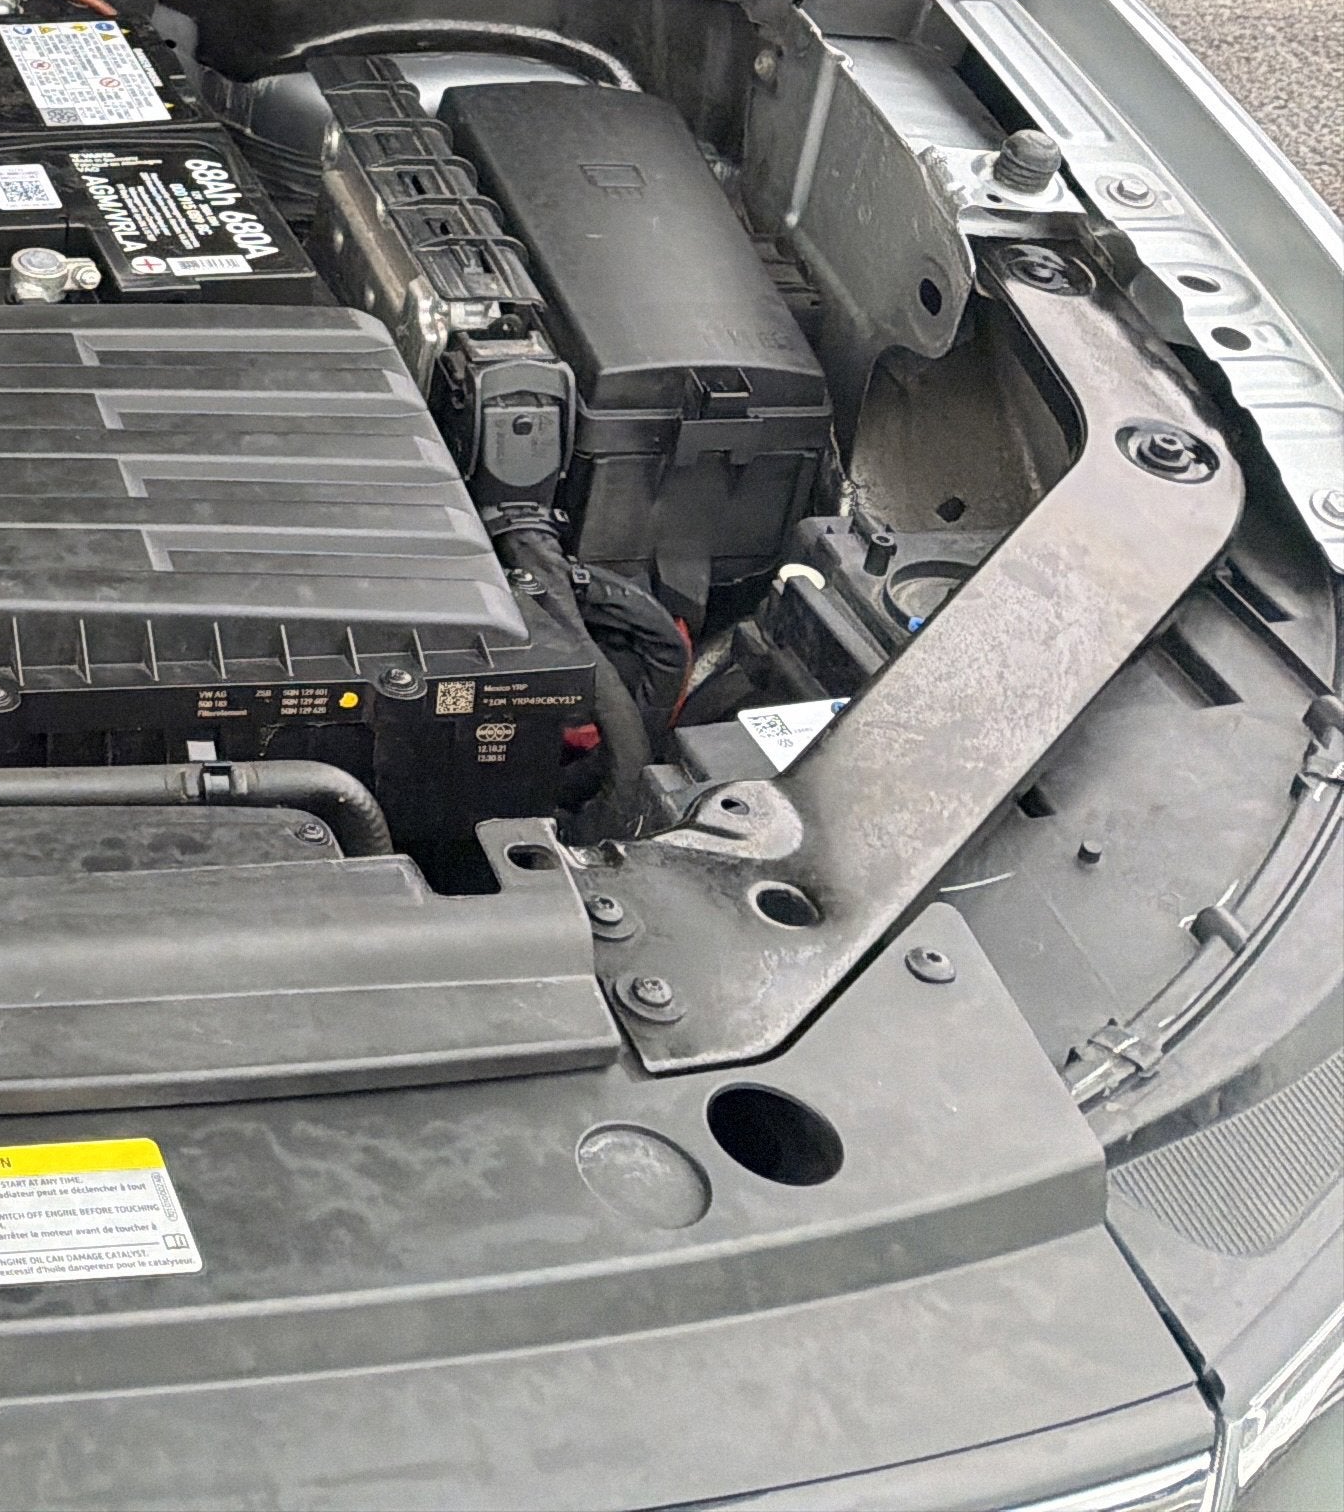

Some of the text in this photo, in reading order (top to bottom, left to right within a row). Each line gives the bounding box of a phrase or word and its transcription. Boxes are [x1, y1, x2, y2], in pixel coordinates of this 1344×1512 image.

[185, 159, 242, 206] 68Ah
[218, 210, 280, 260] 680A
[0, 1179, 27, 1189] START
[27, 1178, 39, 1187] AT
[39, 1177, 58, 1186] ANY
[35, 1187, 58, 1199] peut
[57, 1188, 69, 1196] se
[118, 1183, 126, 1192] à
[125, 1182, 147, 1191] tout
[25, 1210, 43, 1220] OFF
[43, 1208, 79, 1219] ENGINE
[78, 1205, 115, 1216] BEFORE
[113, 1202, 161, 1214] TOUCHING
[28, 1229, 40, 1238] le
[39, 1228, 73, 1238] moteur
[75, 1226, 101, 1236] avant
[101, 1224, 114, 1234] de
[114, 1222, 150, 1233] toucher
[150, 1221, 158, 1231] à
[28, 1255, 45, 1265] OIL
[44, 1254, 65, 1264] CAN
[64, 1251, 105, 1263] DAMAGE
